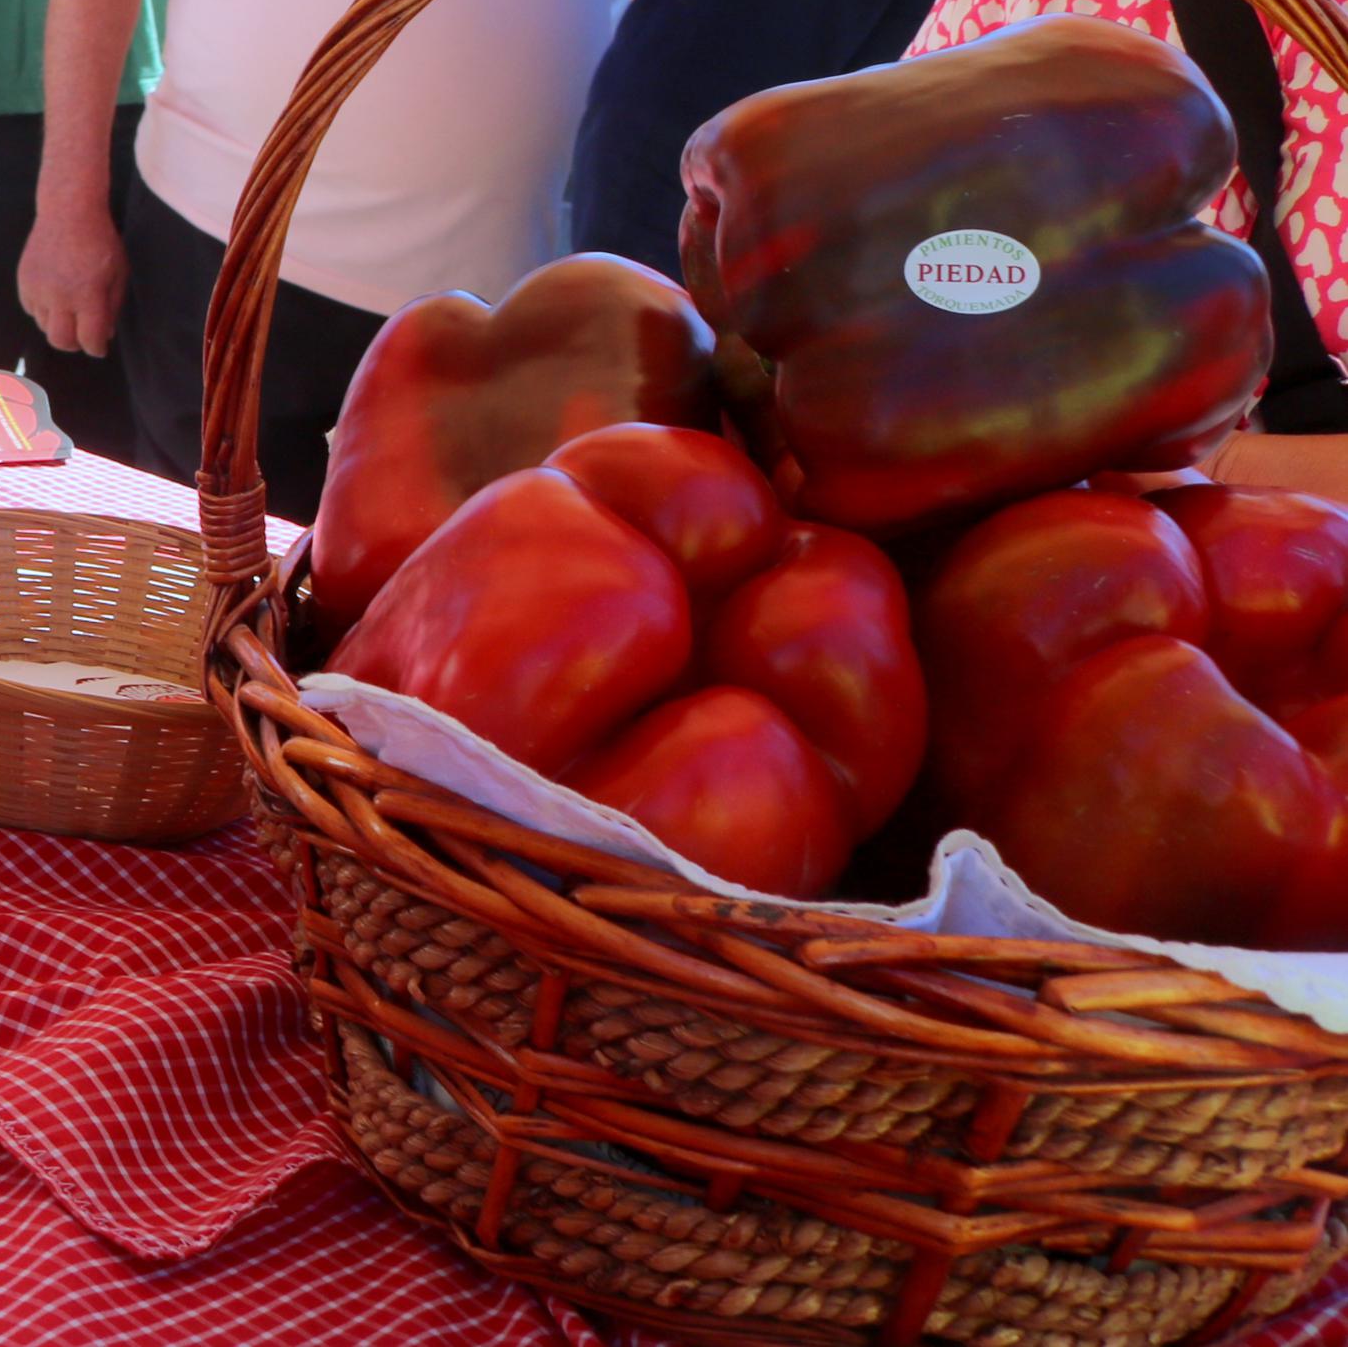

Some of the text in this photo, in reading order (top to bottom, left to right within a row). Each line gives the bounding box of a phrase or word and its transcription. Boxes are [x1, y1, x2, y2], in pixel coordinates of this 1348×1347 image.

[920, 234, 1024, 261] PIMIENTOS
[918, 263, 1025, 284] PIEDAD
[917, 286, 1026, 311] TORQUEMADA
